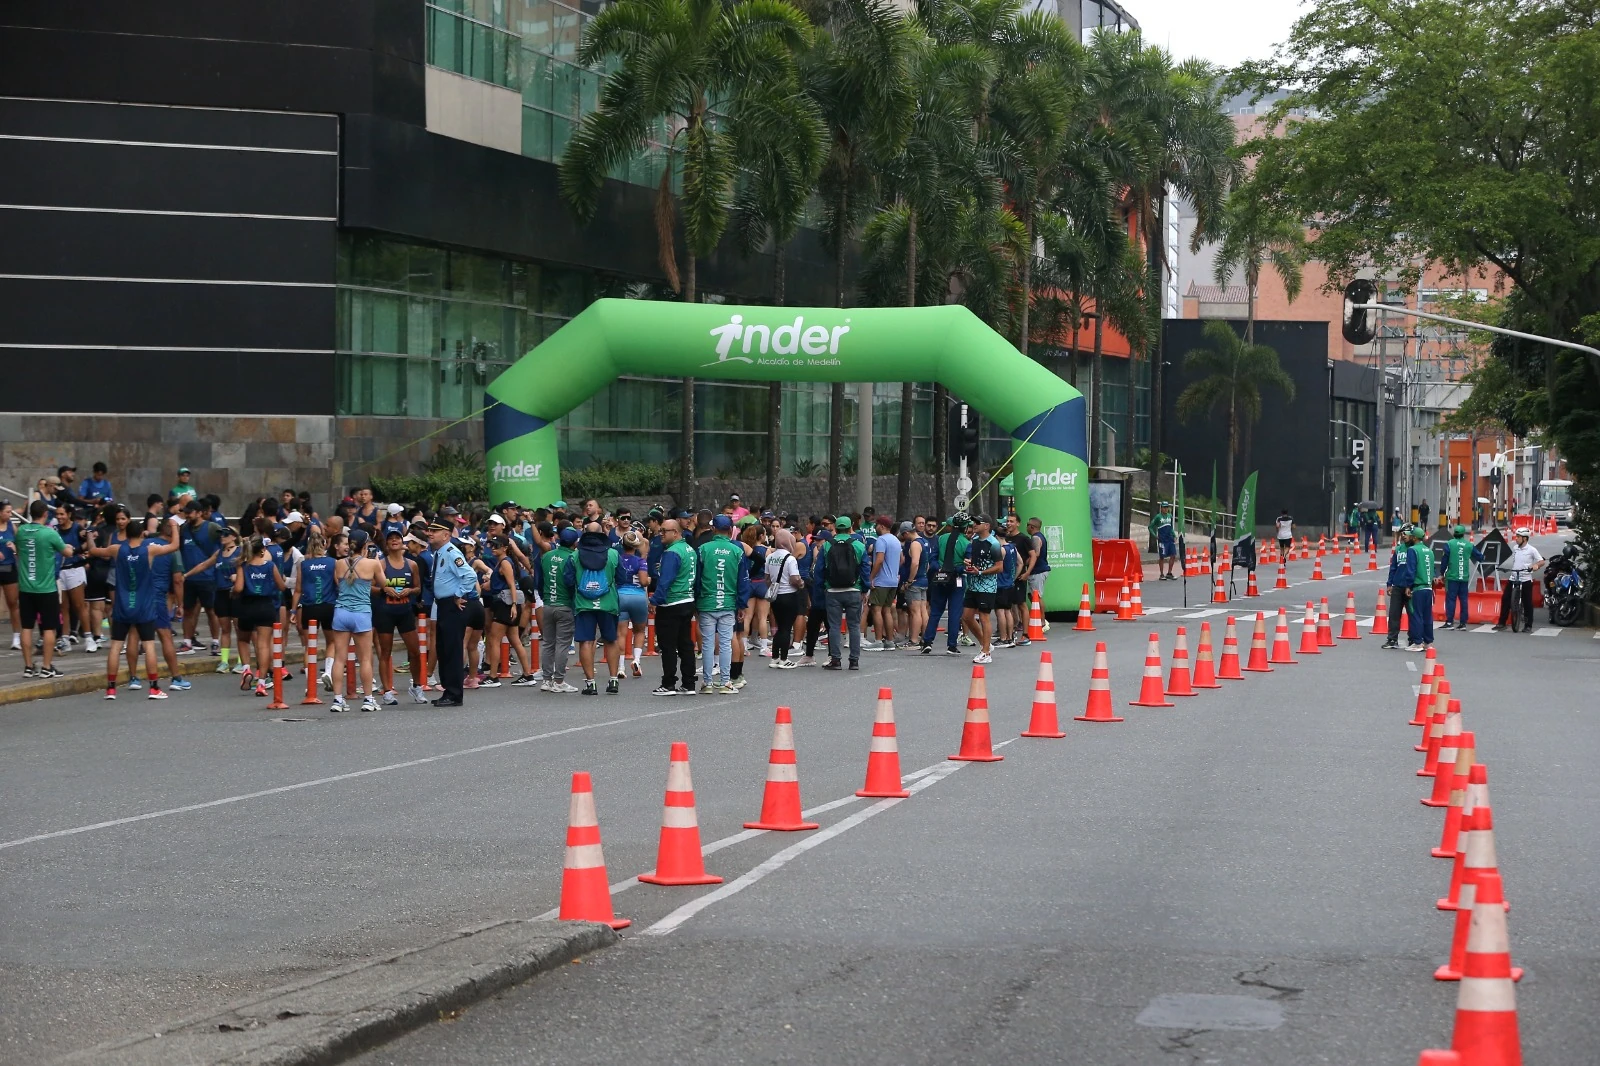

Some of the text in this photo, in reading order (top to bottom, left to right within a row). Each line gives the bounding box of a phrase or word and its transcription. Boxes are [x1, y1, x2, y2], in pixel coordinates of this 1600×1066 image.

[709, 314, 850, 361] inder
[757, 357, 841, 366] Alcaldía de Medellín
[1352, 440, 1365, 455] P
[492, 460, 542, 482] inder
[1025, 467, 1078, 490] inder
[25, 538, 36, 581] MEDELLÍN
